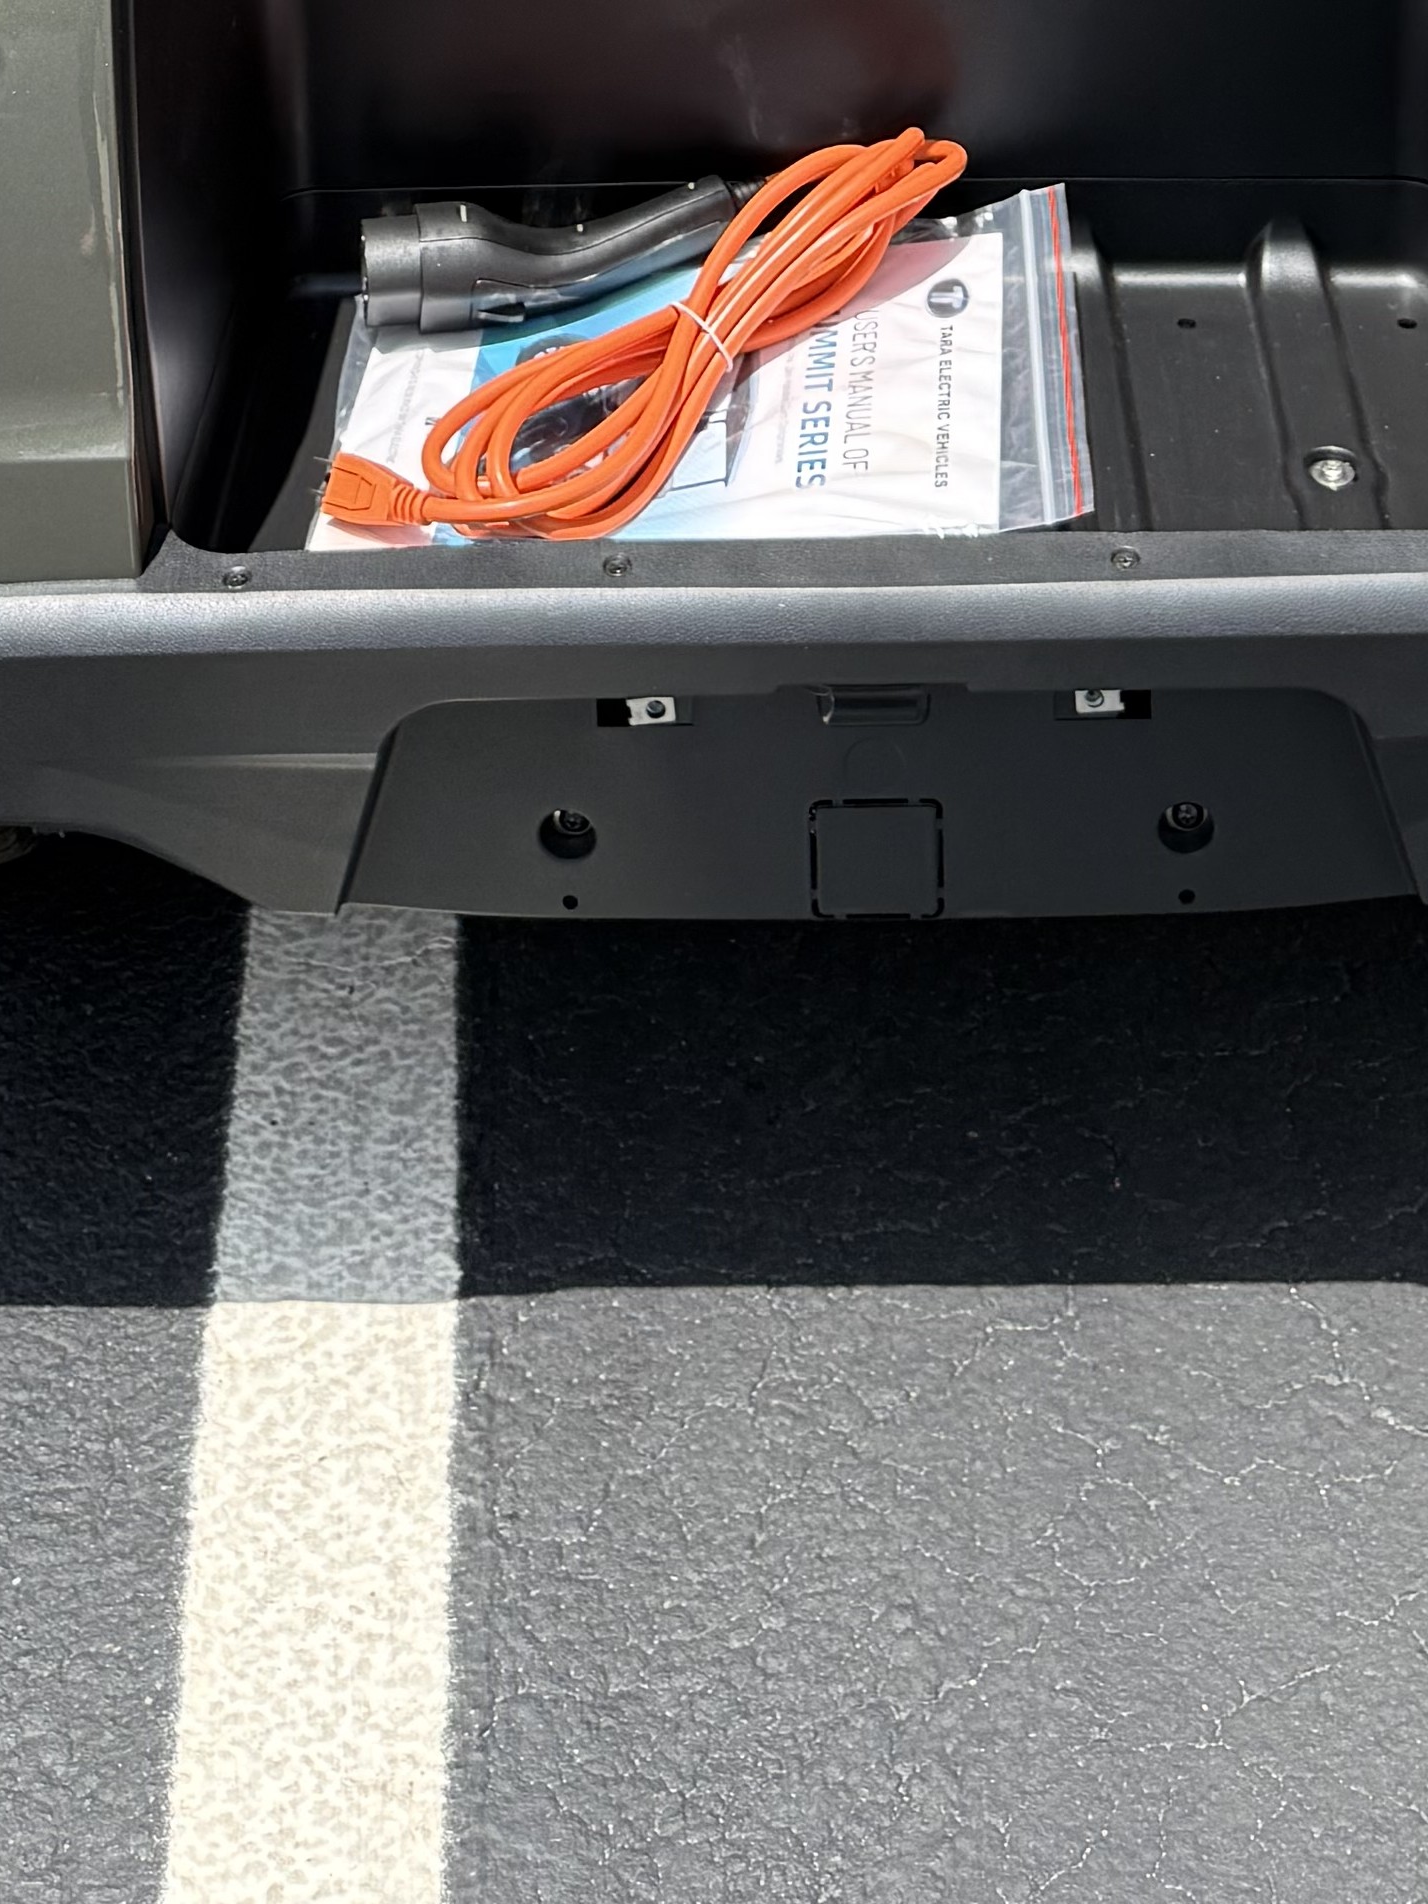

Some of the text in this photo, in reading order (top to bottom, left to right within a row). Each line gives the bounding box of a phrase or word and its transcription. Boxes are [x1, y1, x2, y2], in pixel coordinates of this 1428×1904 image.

[795, 399, 832, 489] SERIES
[843, 369, 875, 444] MANUAL
[934, 324, 954, 488] TARA ELECTRIC VEHICLES
[841, 448, 870, 471] OF
